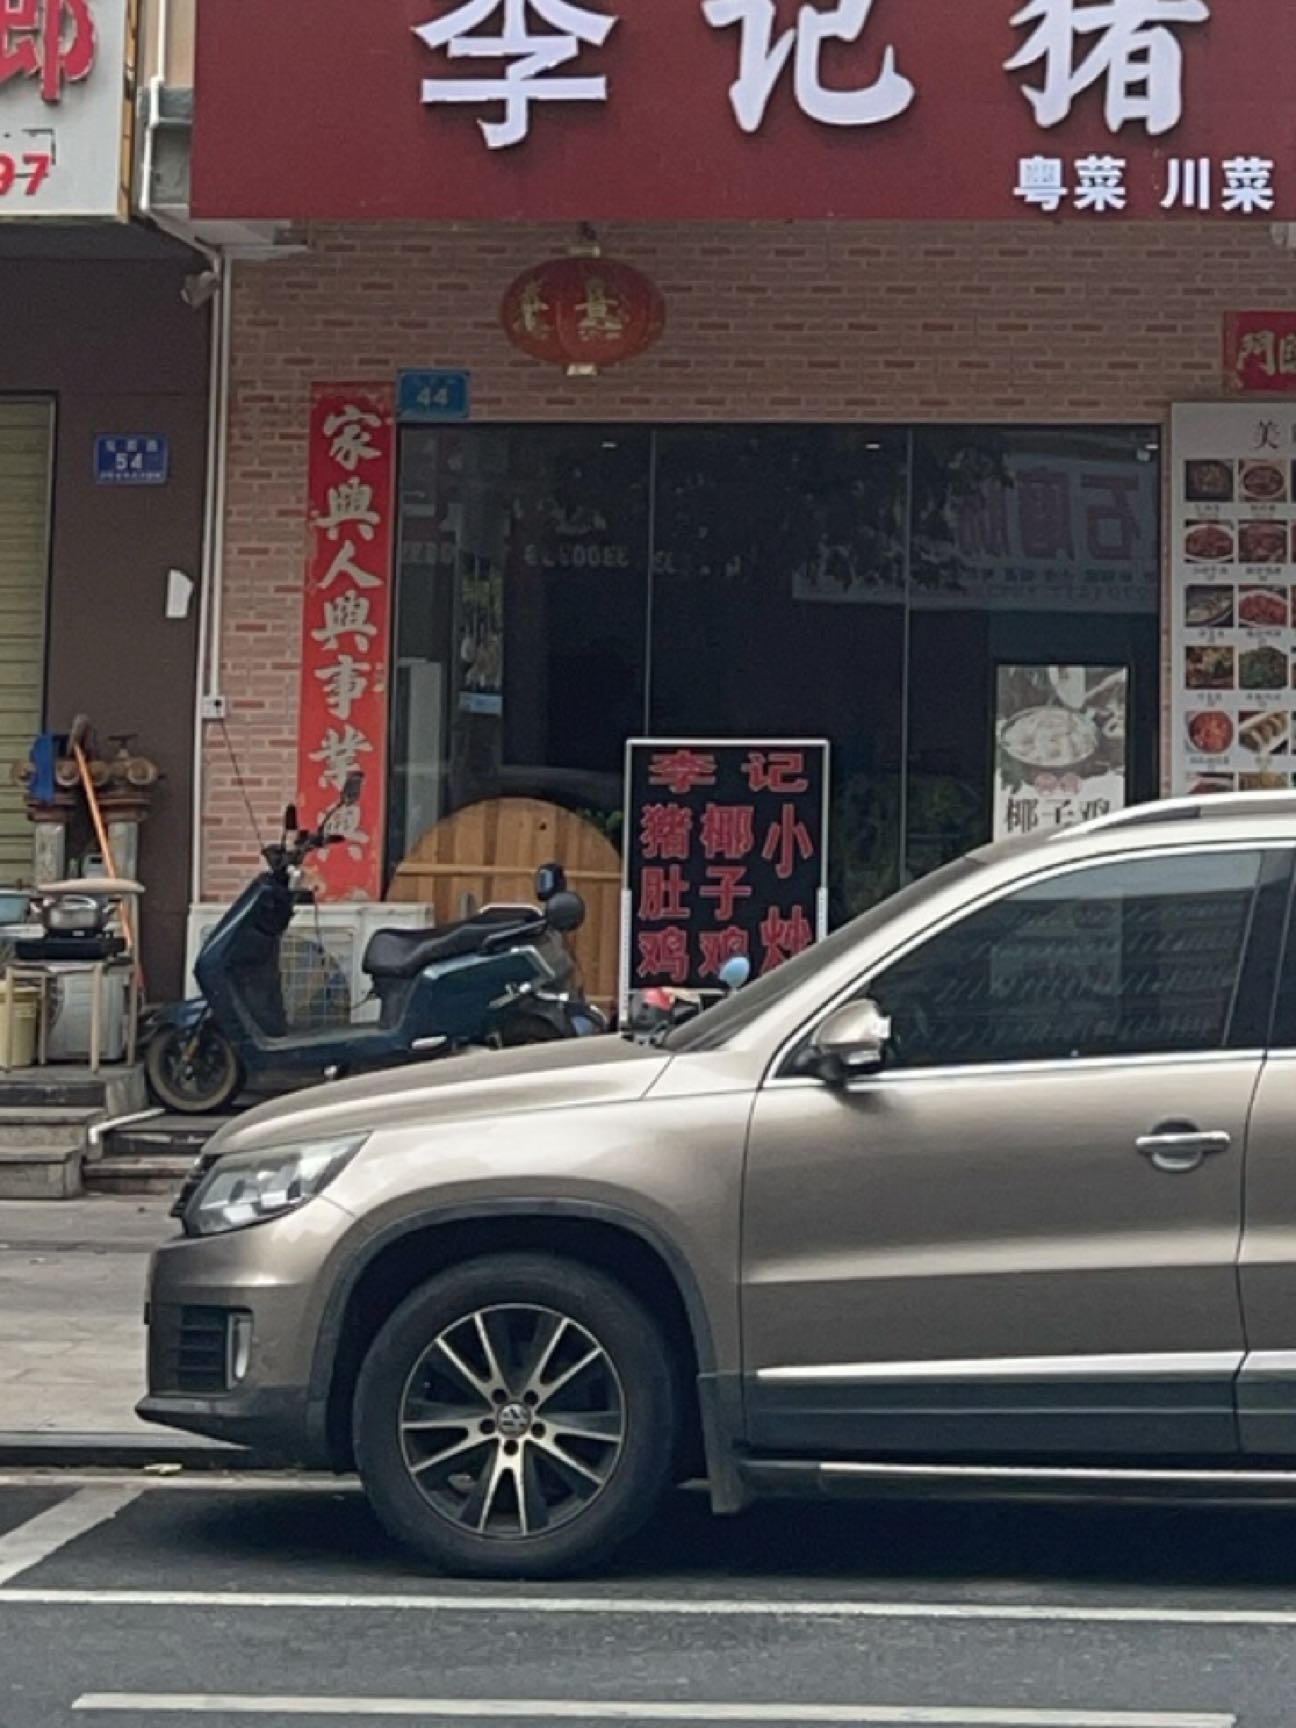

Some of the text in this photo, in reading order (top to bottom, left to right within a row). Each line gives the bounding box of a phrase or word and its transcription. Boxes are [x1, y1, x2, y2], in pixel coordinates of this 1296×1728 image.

[1013, 155, 1127, 211] 粤菜
[1160, 156, 1274, 212] 川菜
[417, 386, 448, 408] 44
[115, 453, 144, 470] 54
[647, 749, 809, 794] 李记
[638, 802, 693, 983] 猪肚鸡
